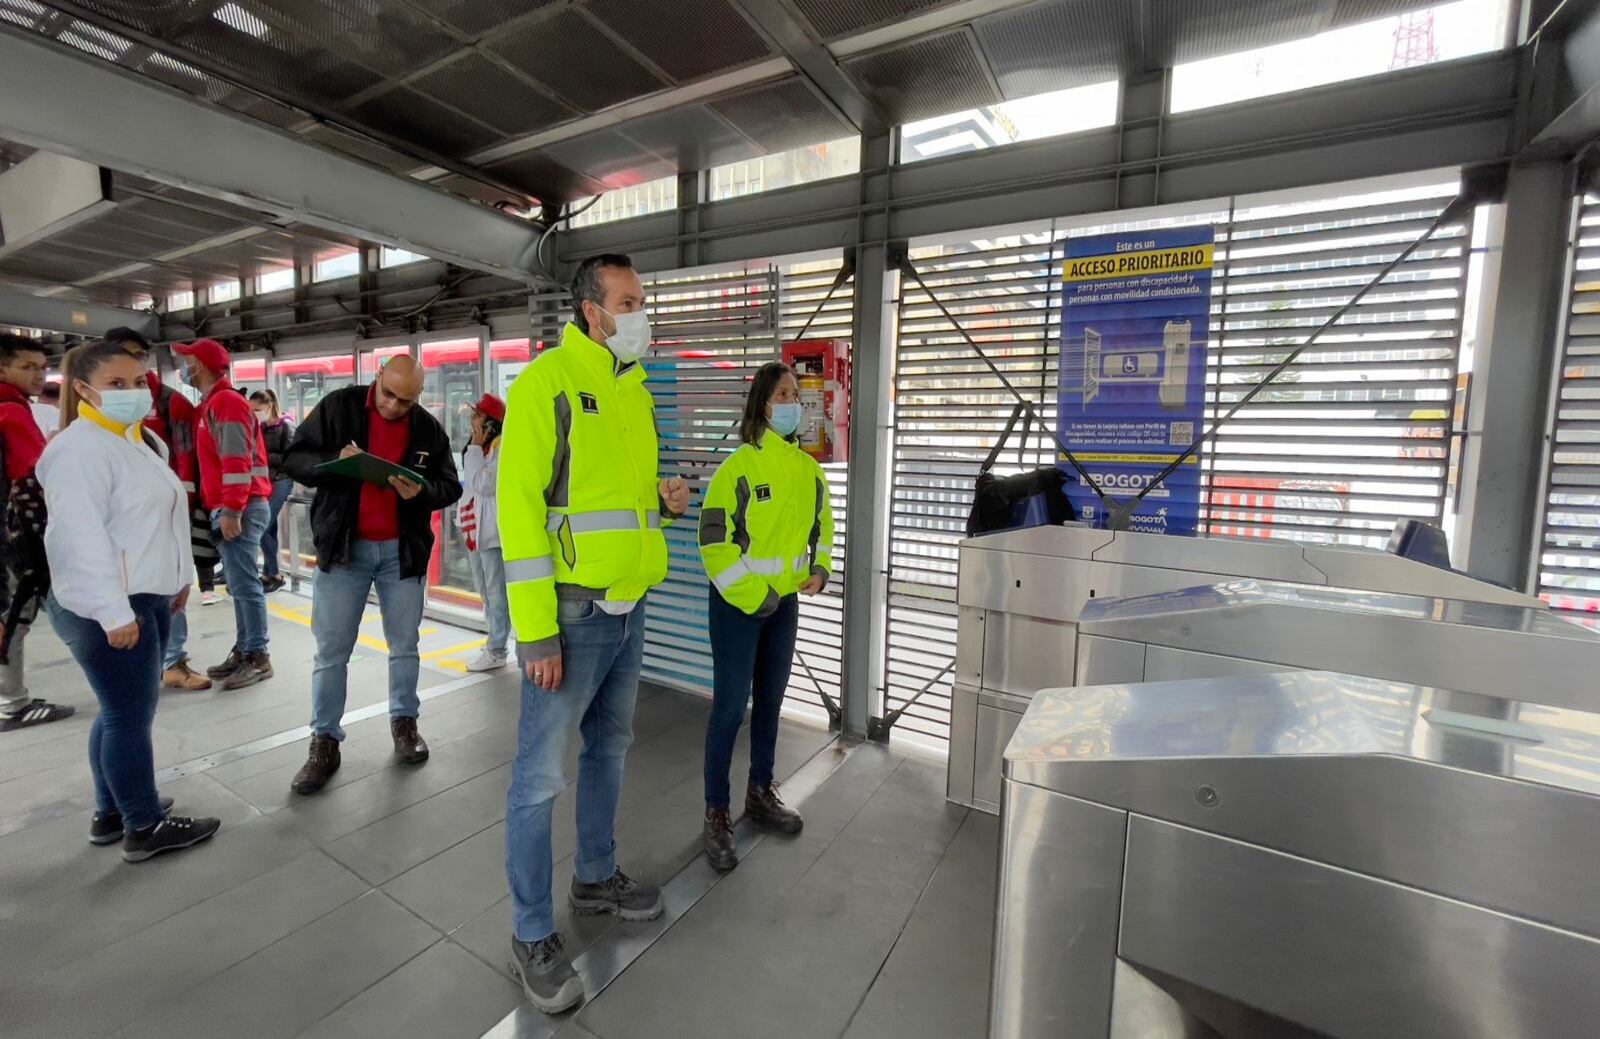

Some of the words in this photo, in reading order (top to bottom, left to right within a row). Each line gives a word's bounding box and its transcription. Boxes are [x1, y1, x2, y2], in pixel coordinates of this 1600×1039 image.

[1116, 241, 1132, 251] Este
[1134, 242, 1143, 250] es
[1144, 240, 1155, 249] un
[1070, 260, 1115, 277] ACCESO
[1119, 250, 1204, 273] PRIORITARIO
[1077, 282, 1093, 293] para
[1094, 280, 1125, 292] personas
[1126, 279, 1139, 288] con
[1140, 274, 1188, 287] discapacidad
[1188, 274, 1194, 284] y
[1068, 294, 1099, 305] personas
[1100, 292, 1113, 301] con
[1114, 288, 1150, 300] movilidad
[1151, 285, 1202, 297] condicionada.
